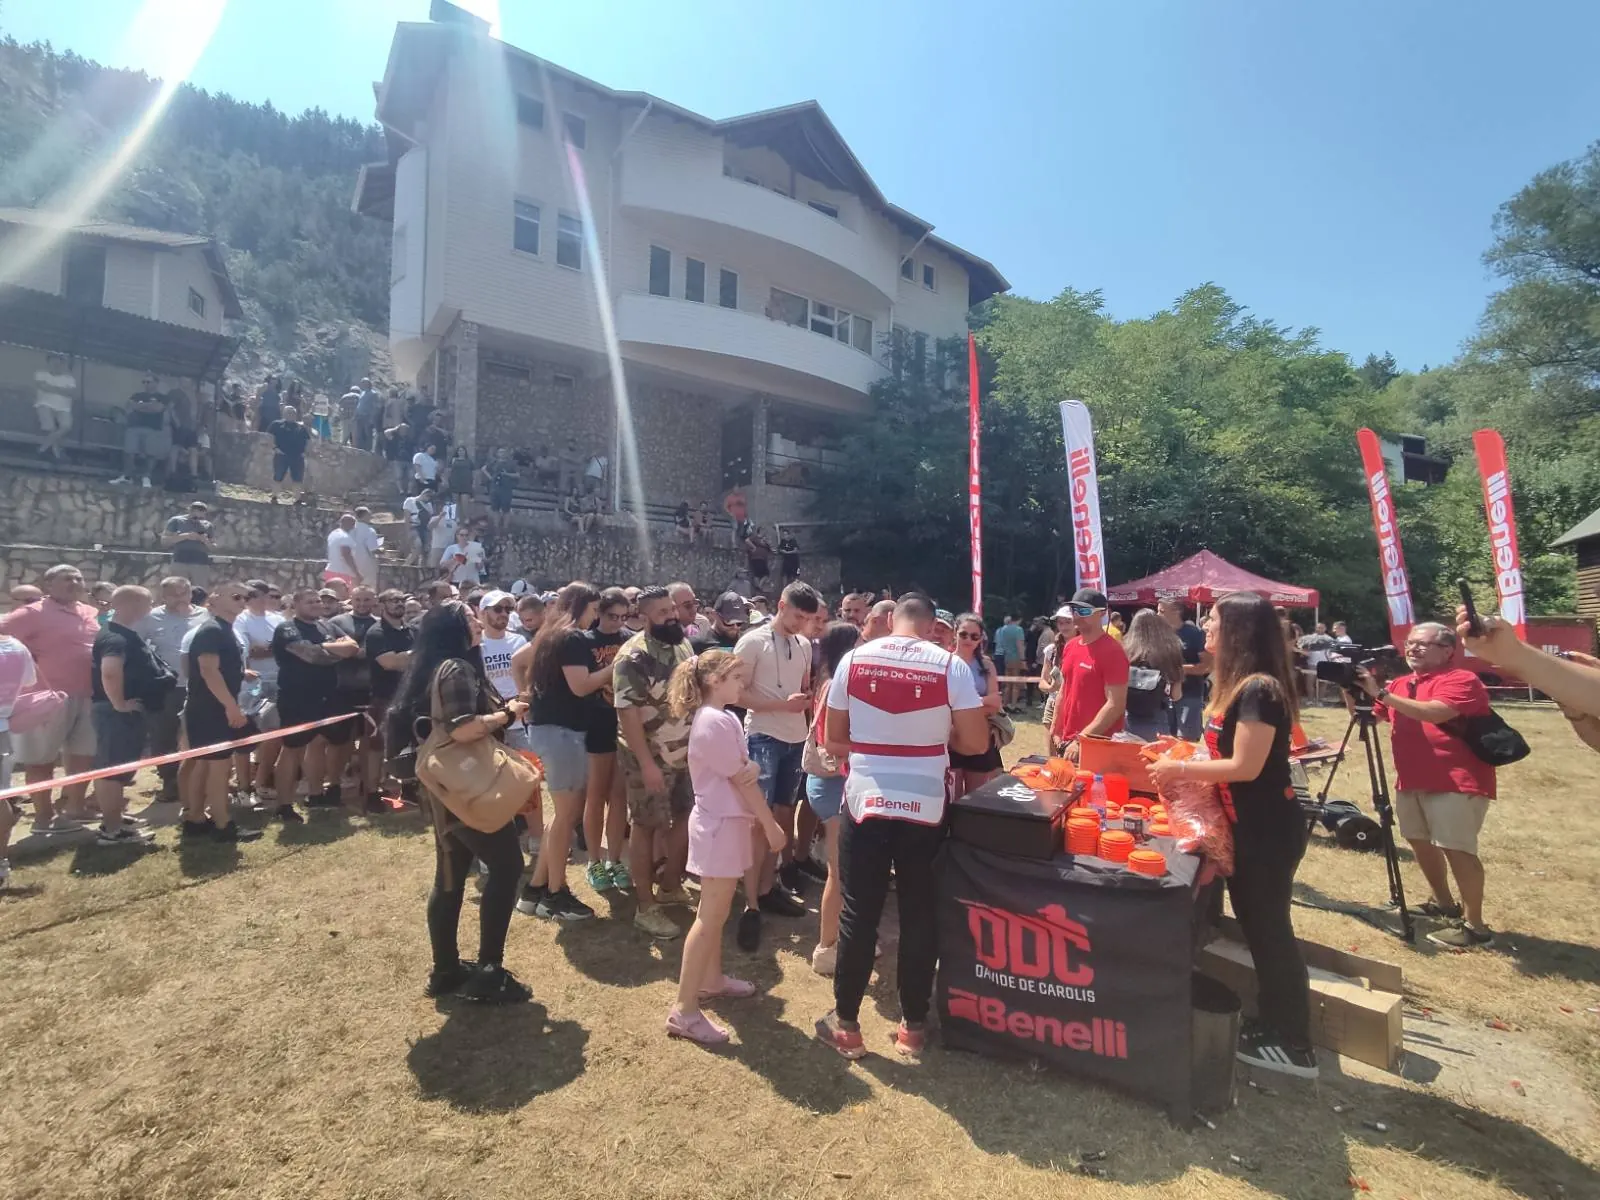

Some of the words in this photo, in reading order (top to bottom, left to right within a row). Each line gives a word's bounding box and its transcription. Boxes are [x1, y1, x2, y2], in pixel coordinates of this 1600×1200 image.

[888, 643, 922, 653] Benelli
[484, 653, 513, 664] DESIG
[857, 666, 889, 677] Davide
[875, 796, 921, 813] Benelli
[1019, 978, 1037, 993] DE
[1038, 982, 1096, 1003] CAROLIS
[979, 996, 1128, 1059] Benelli
